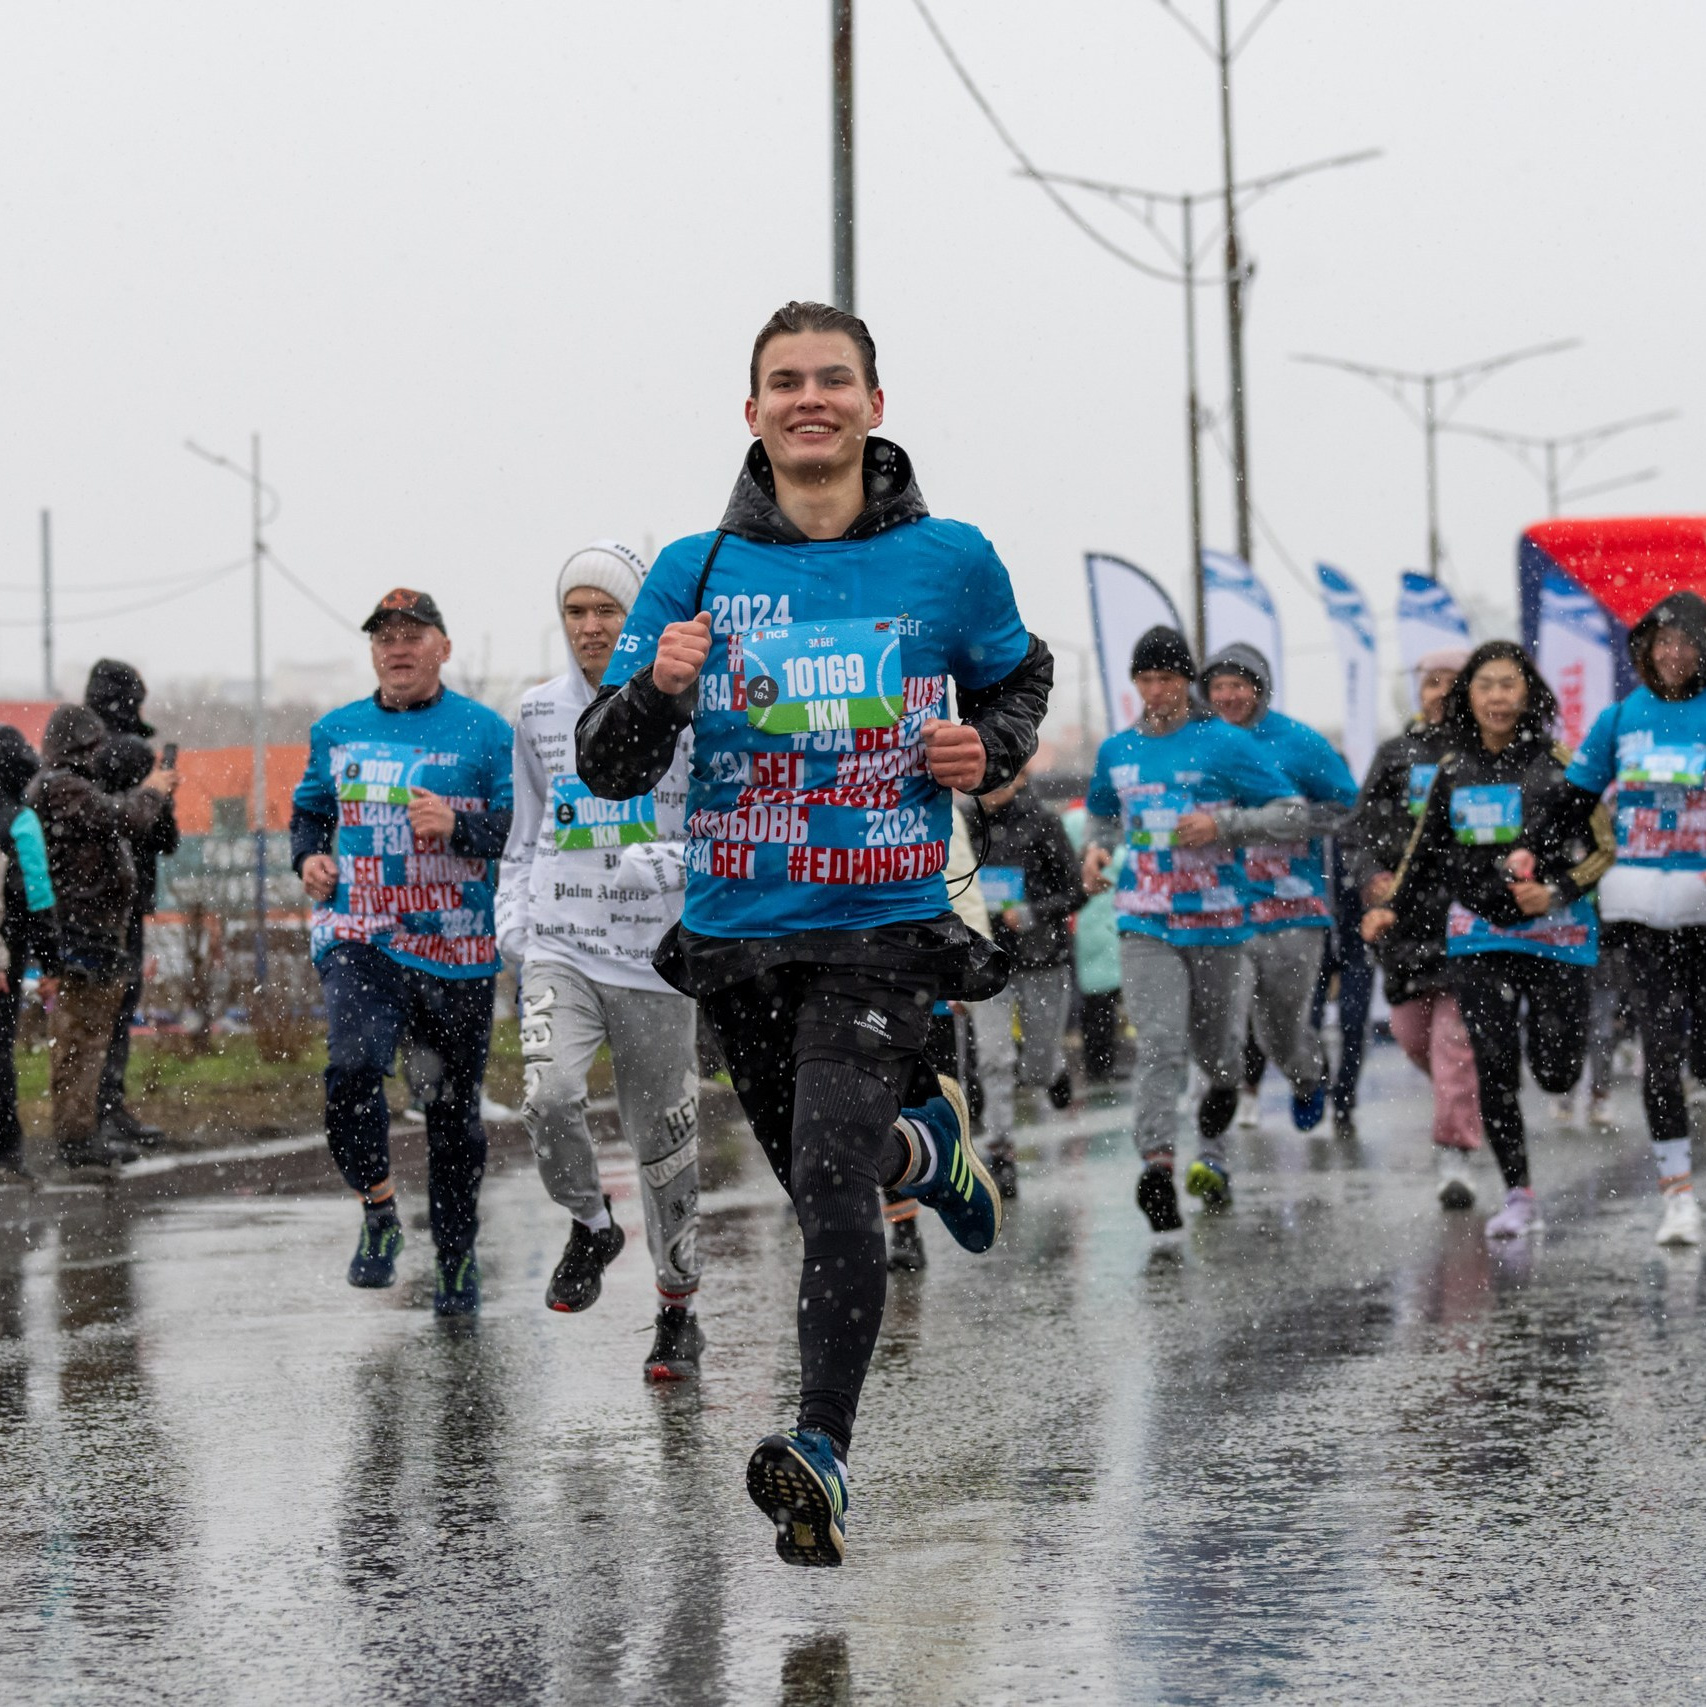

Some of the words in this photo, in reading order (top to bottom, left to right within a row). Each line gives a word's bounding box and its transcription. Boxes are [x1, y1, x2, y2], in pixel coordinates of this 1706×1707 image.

[712, 594, 793, 635] 2024
[766, 629, 789, 639] ПСБ
[782, 653, 866, 698] 10169
[754, 690, 769, 700] 18+
[709, 751, 805, 789] #ЗАБЕГ
[575, 796, 630, 825] 10027
[866, 806, 929, 846] 2024
[349, 882, 463, 916] #ГОРДОСТЬ
[554, 883, 593, 901] Palm
[597, 884, 651, 905] Angels
[535, 923, 565, 937] Palm
[568, 923, 607, 938] Angels
[610, 913, 633, 924] Palm
[853, 1019, 892, 1041] NORDSKI
